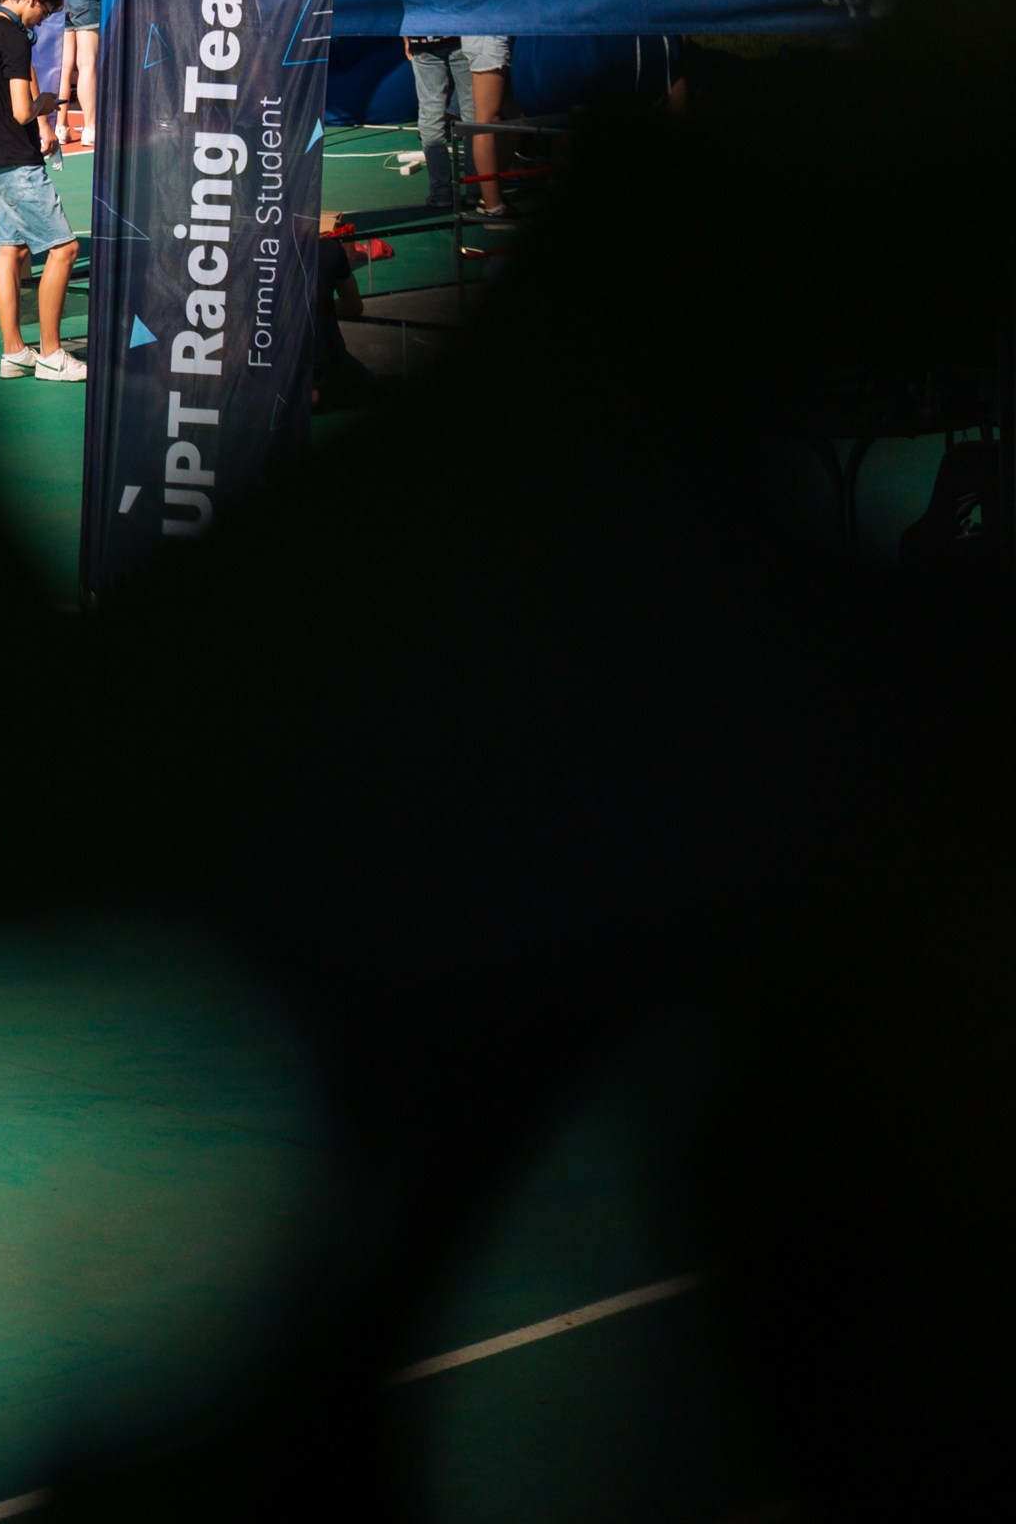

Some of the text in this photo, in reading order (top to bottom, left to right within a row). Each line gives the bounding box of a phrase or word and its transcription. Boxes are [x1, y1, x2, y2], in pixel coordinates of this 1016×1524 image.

[171, 131, 248, 376] Racing
[247, 96, 282, 368] Formula Student
